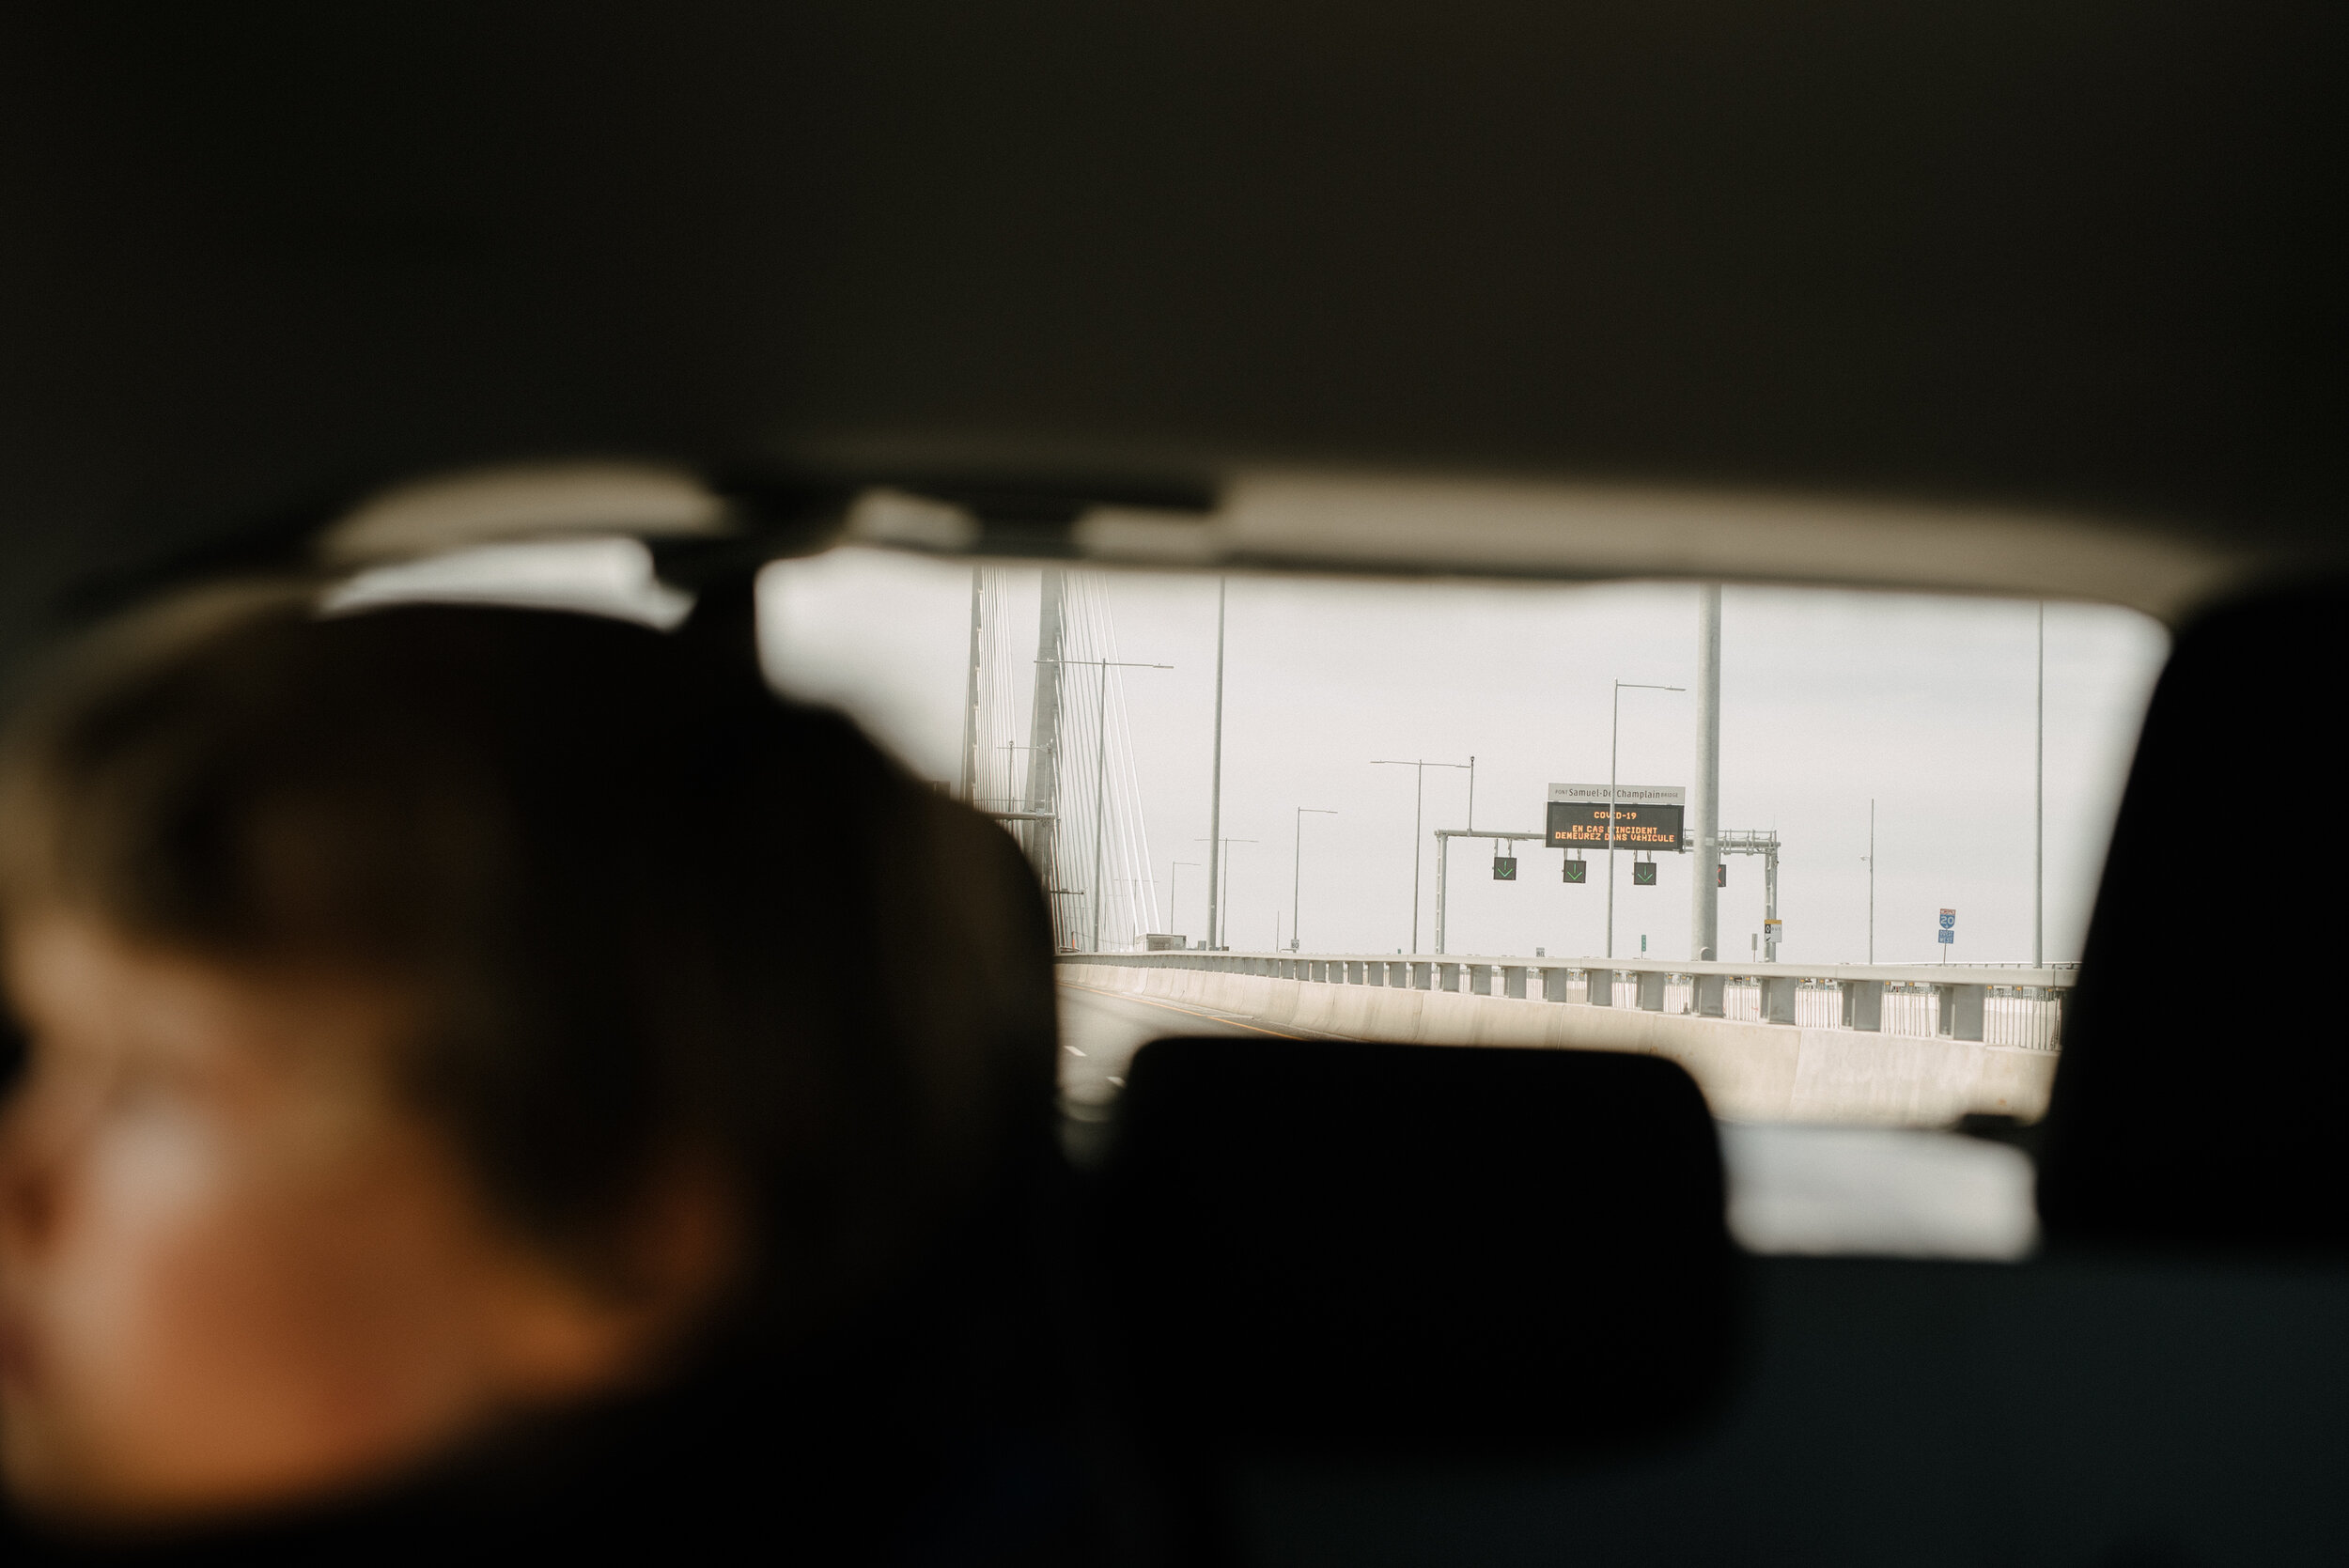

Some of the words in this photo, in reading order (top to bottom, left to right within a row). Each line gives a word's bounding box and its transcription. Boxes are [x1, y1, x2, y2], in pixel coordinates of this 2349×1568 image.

[1616, 789, 1660, 800] Champlain
[1555, 831, 1601, 841] DEMEUREZ
[1940, 916, 1954, 924] 20
